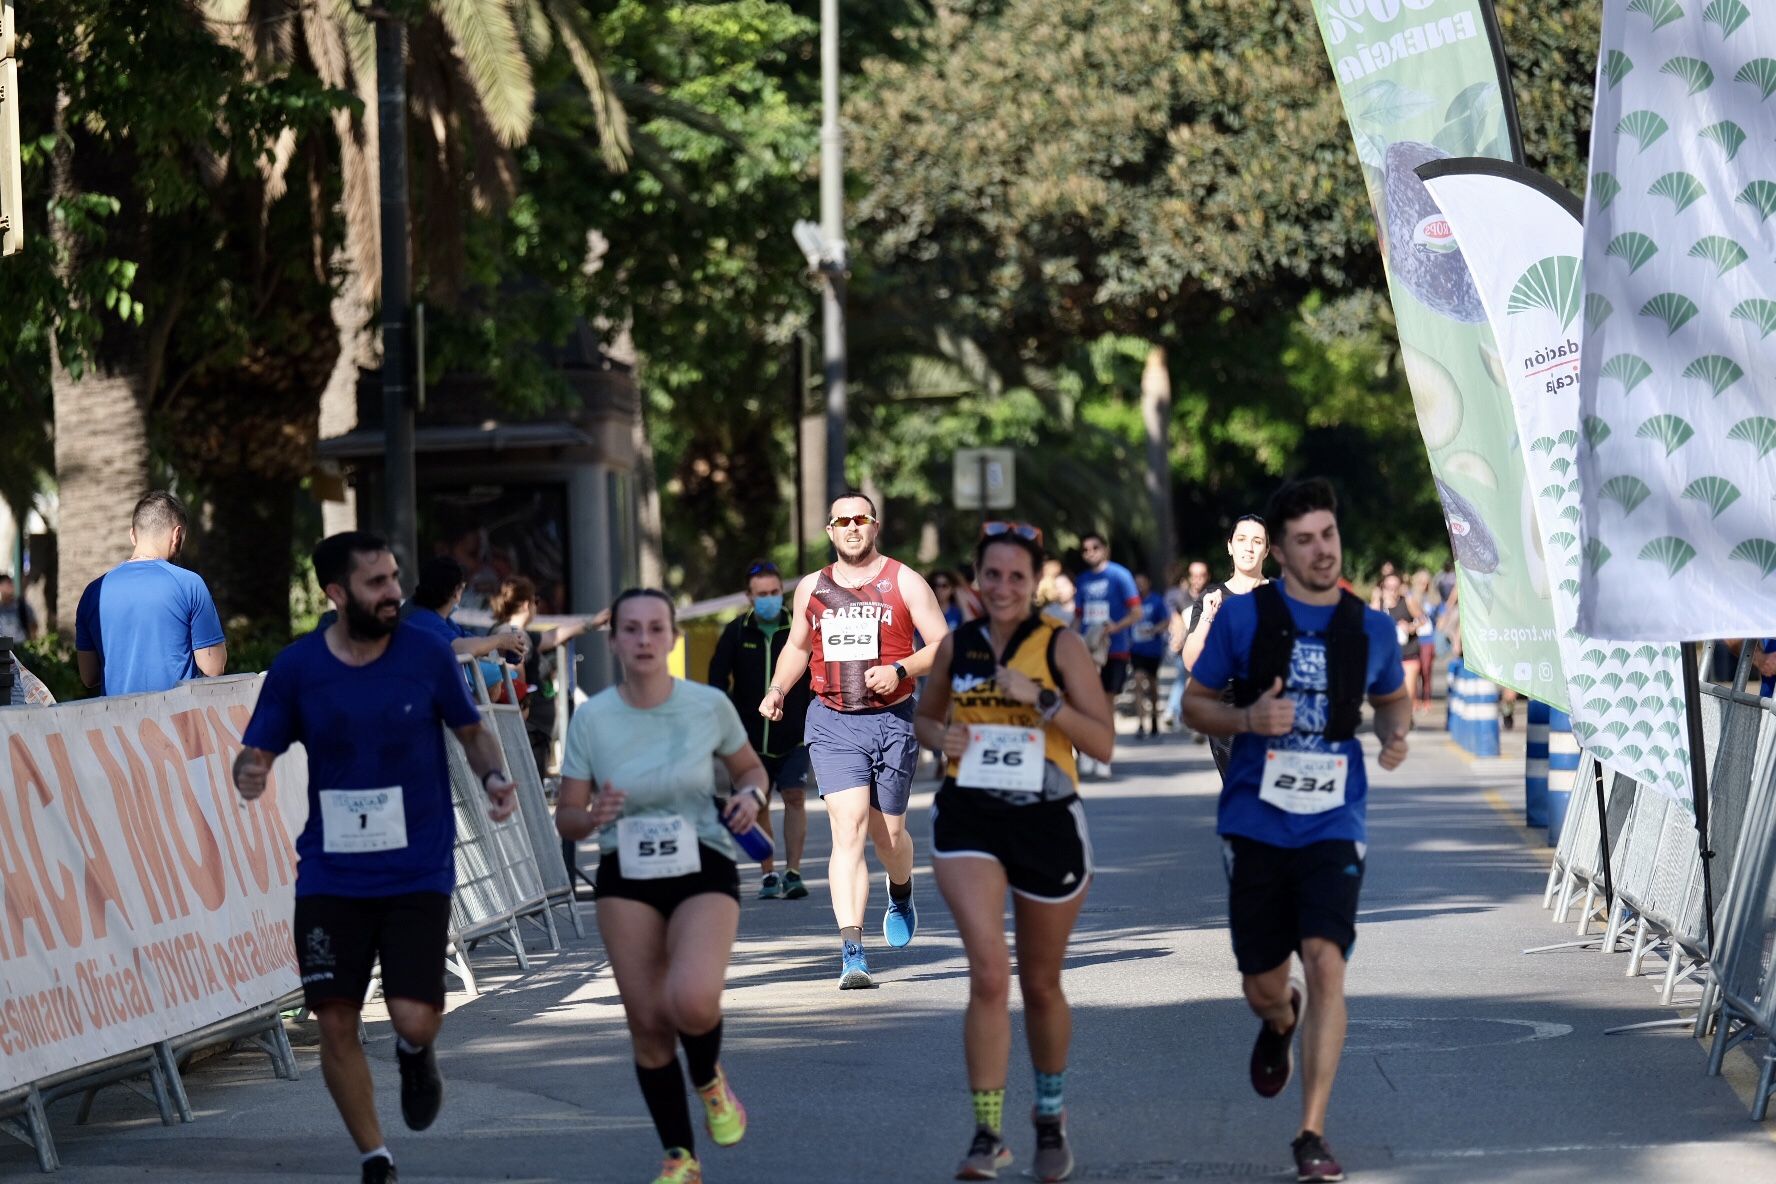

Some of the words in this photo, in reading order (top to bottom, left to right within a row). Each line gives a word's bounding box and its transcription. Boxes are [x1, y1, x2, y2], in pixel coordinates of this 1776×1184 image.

[981, 749, 1024, 767] 56
[1273, 773, 1337, 794] 234
[358, 813, 368, 830] 1
[637, 840, 679, 858] 55
[213, 930, 267, 1004] para
